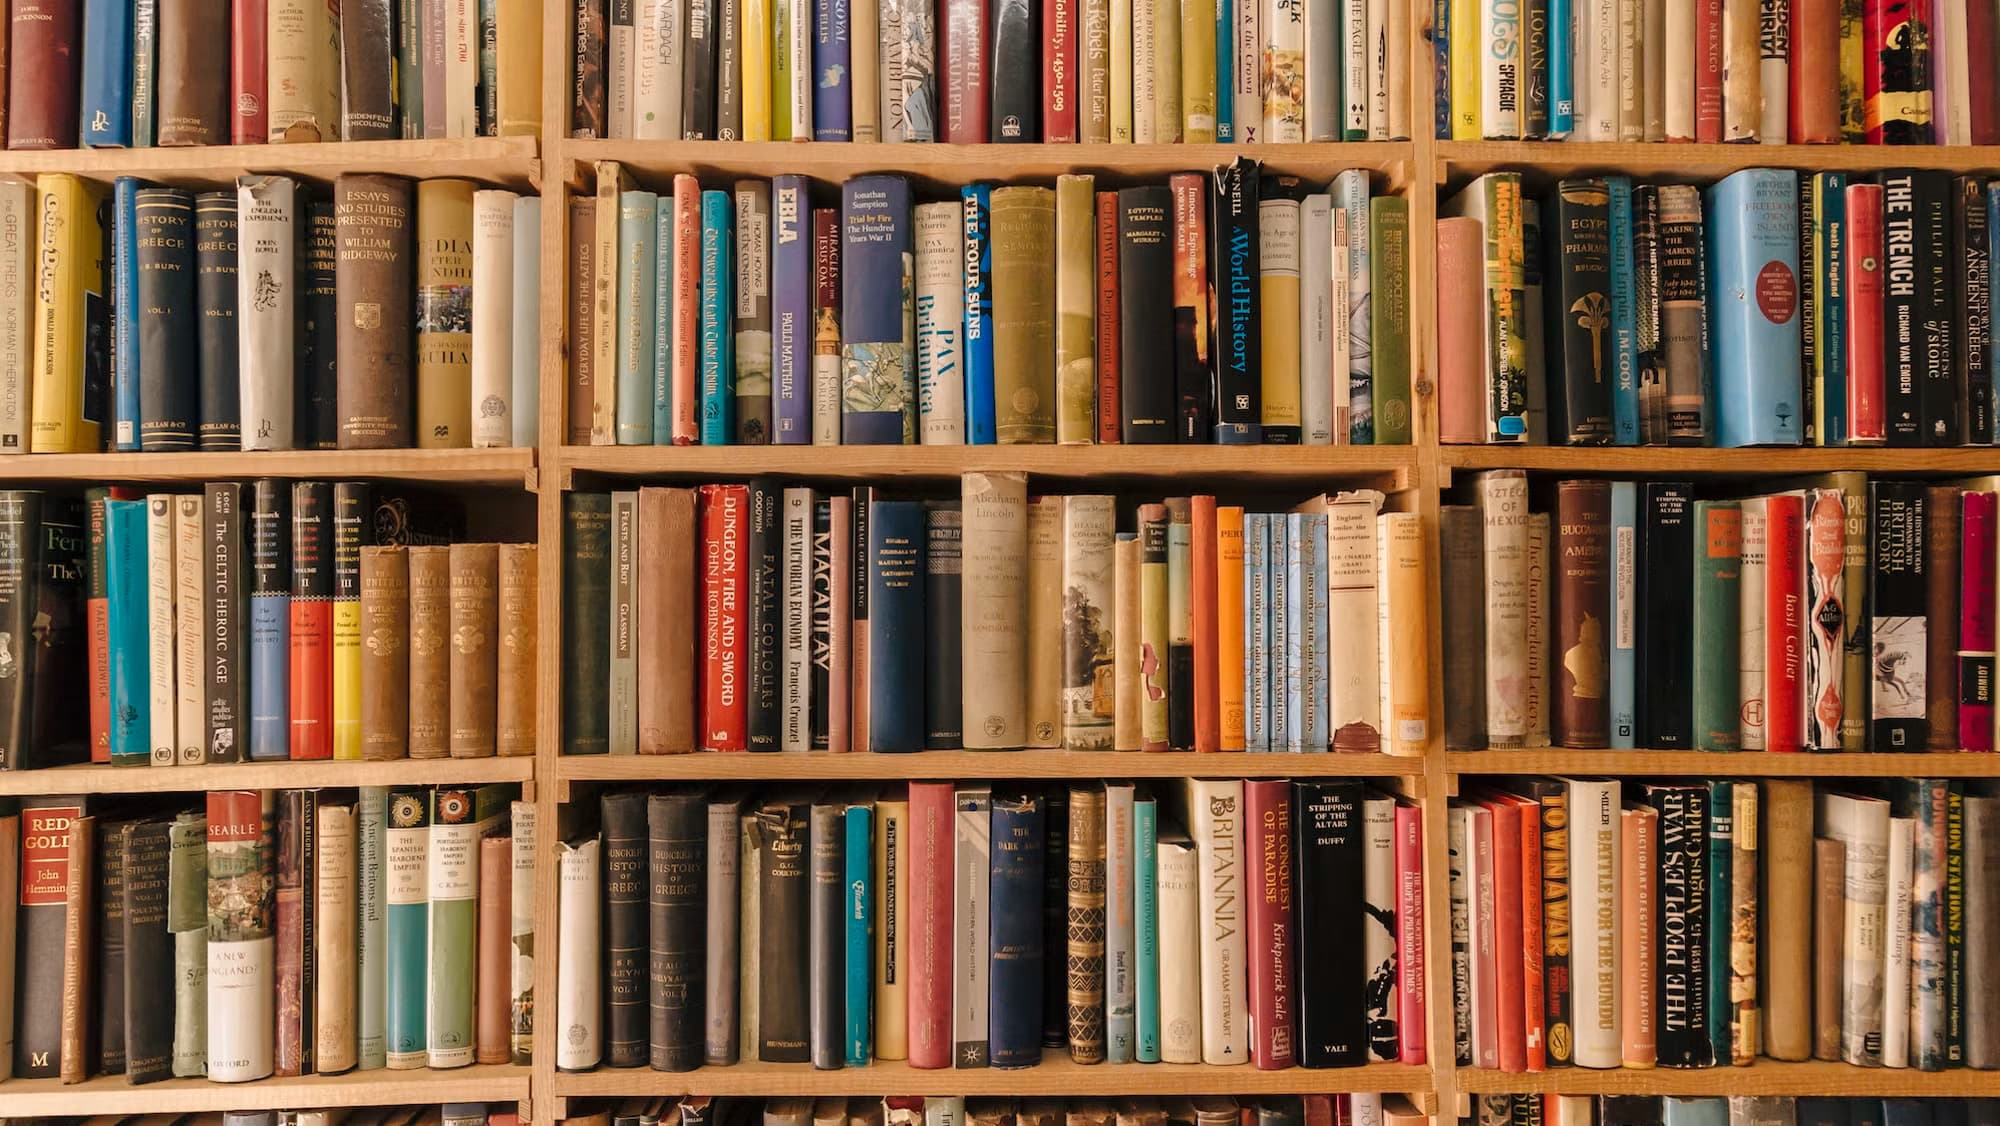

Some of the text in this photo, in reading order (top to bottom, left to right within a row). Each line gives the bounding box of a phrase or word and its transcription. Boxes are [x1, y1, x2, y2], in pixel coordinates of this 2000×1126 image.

[658, 11, 672, 64] ARDAGH
[820, 14, 828, 44] ELLIS
[967, 6, 980, 90] FAREWELL
[1351, 19, 1363, 58] EAGLE
[1530, 9, 1544, 70] LOGAN
[1709, 22, 1718, 72] MEXICO
[887, 35, 903, 129] AMBITION
[949, 43, 962, 131] TRUMPETS
[1053, 52, 1065, 111] 1450-1509
[1092, 68, 1105, 93] Peter
[1244, 30, 1254, 95] the Crown
[1499, 64, 1515, 112] SPRAGUE
[1091, 96, 1104, 122] Earle
[347, 191, 389, 202] ESSAYS
[356, 204, 405, 216] STUDIES
[778, 188, 798, 244] EBLA
[850, 215, 892, 225] Trial by Fire
[852, 200, 888, 211] Sumption
[854, 191, 887, 200] Jonathan
[6, 215, 17, 252] GREAT
[338, 216, 403, 228] PRESENTED
[345, 238, 391, 249] WILLIAM
[362, 227, 373, 235] TO
[847, 223, 894, 232] The Hundred
[850, 233, 892, 242] Years War II
[1887, 177, 1914, 296] THE TRENCH
[341, 250, 397, 262] RIDGEWAY
[819, 236, 829, 288] JESUS OAK
[829, 224, 838, 278] MIRACLES
[966, 194, 980, 340] THE FOUR SUNS
[1230, 232, 1250, 293] World
[1650, 249, 1658, 286] HISTORY
[1829, 222, 1840, 297] Death in England
[1931, 202, 1944, 306] PHILIP BALL
[6, 259, 17, 298] TREKS
[6, 308, 17, 349] NORMAN
[580, 245, 589, 386] EVERYDAY LIFE OF THE AZTECS
[1651, 298, 1659, 342] DENMARK
[1967, 248, 1981, 370] ANCIENT GREECE
[782, 312, 793, 399] PAOLO MATTHIAE
[917, 295, 936, 415] Britannica
[937, 330, 955, 375] PAX
[1230, 299, 1250, 372] History
[1898, 305, 1911, 394] RICHARD VAN EMDEN
[1923, 320, 1940, 378] of stone
[6, 352, 17, 420] ETHERINGTON
[90, 500, 105, 543] Hitler's
[755, 490, 763, 532] GOODWIN
[974, 493, 1019, 505] Abraham
[976, 507, 1015, 518] Lincoln
[1336, 514, 1363, 522] England
[706, 539, 719, 576] JOHN
[1879, 500, 1890, 574] HISTORY
[1891, 501, 1904, 571] BRITISH
[1906, 554, 1913, 565] TO
[216, 521, 228, 684] The CELTIC HEROIC AGE
[720, 497, 736, 706] DUNGEON, FIRE AND SWORD
[789, 518, 803, 651] THE VICTORIAN ECONOMY
[813, 532, 830, 672] MACAULAY
[619, 603, 629, 650] GLASSMAN
[707, 590, 719, 660] ROBINSON
[762, 554, 774, 709] FATAL COLOURS
[1785, 594, 1798, 681] Basil Collier
[788, 661, 803, 743] François Crouzet
[1978, 665, 1988, 701] SCHMIDT
[32, 818, 71, 831] RED
[209, 824, 255, 835] SEARLE
[1309, 803, 1353, 812] STRIPPING
[1315, 812, 1347, 820] OF THE
[1315, 820, 1347, 829] ALTARS
[1542, 793, 1567, 827] TO
[1263, 811, 1276, 903] OF PARADISE
[1278, 801, 1290, 912] THE CONQUEST
[1318, 837, 1345, 845] DUFFY
[1544, 829, 1568, 879] WIN
[37, 869, 59, 880] John
[368, 819, 380, 922] Ancient Britons and
[1210, 796, 1236, 942] BRITANNIA
[1949, 792, 1961, 945] ACTION STATIONS 2
[1545, 900, 1568, 957] WAR
[1598, 791, 1613, 1030] MILLER BATTLE FOR THE BUNDU
[1663, 794, 1686, 1031] THE PEOPLE'S WAR
[1222, 949, 1231, 1038] GRAHAM STEWART
[1270, 923, 1286, 1020] Kirkpatrick Sale
